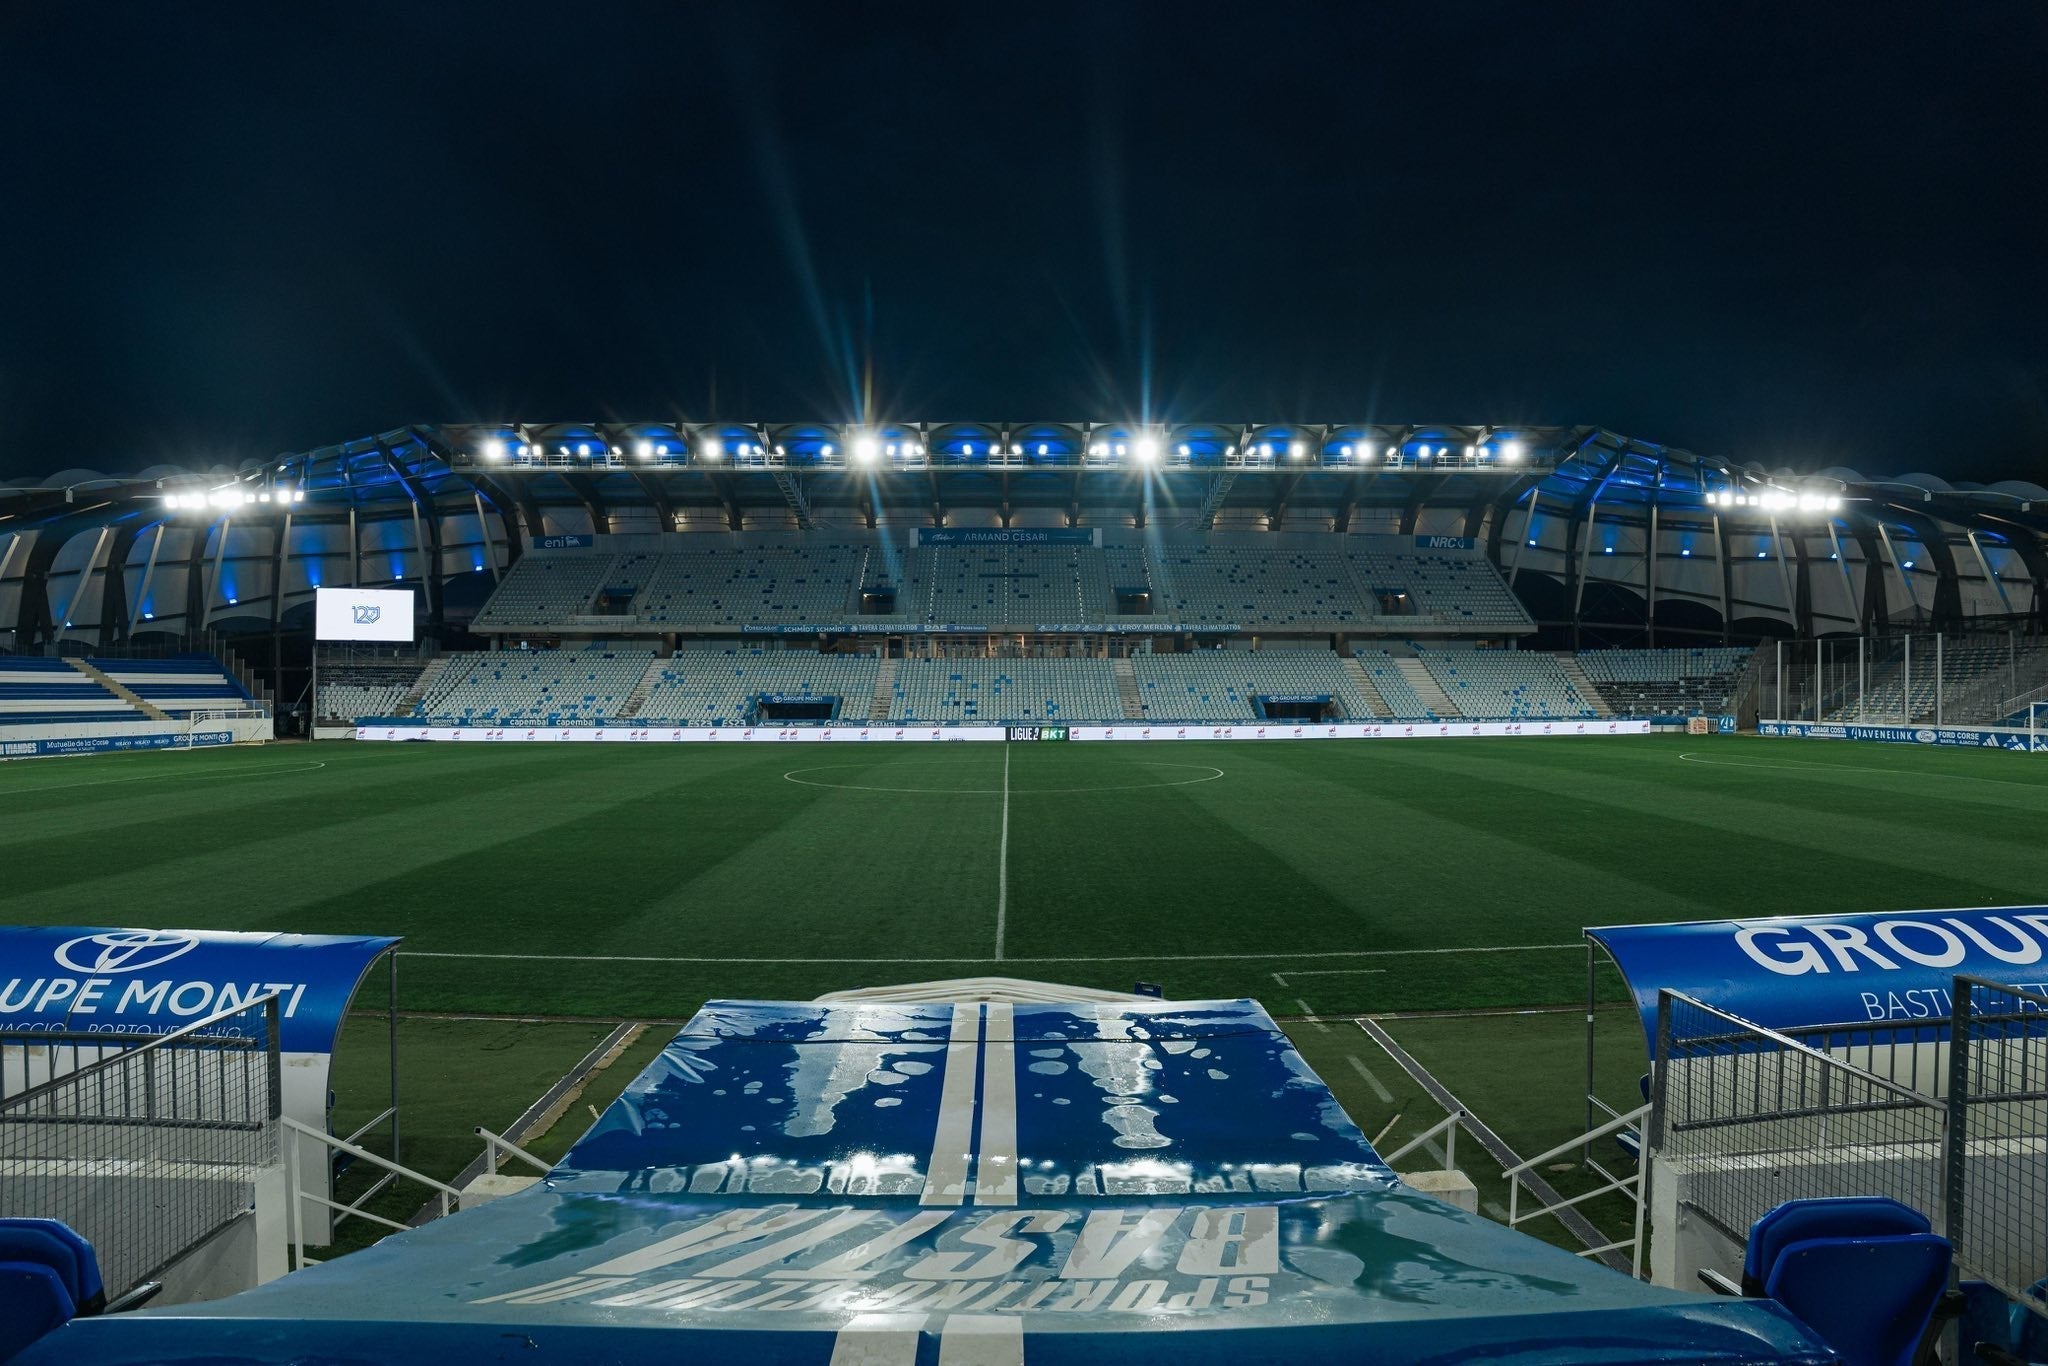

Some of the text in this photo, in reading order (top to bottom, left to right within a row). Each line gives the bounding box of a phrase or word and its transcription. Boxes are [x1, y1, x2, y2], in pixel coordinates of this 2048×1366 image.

[964, 533, 1009, 541] ARMAND
[544, 537, 564, 548] eni
[1430, 536, 1457, 548] NRC
[924, 624, 948, 632] DAF
[1118, 624, 1143, 632] LEROY
[509, 718, 549, 726] capembal
[556, 718, 595, 726] capembal
[1010, 727, 1033, 741] LIGUE
[1033, 727, 1040, 741] 2
[1041, 727, 1066, 741] BKT
[1810, 726, 1829, 734] GARAGE
[1862, 729, 1913, 740] AVENELINK
[173, 734, 199, 743] GROUPE
[199, 733, 218, 741] MONTI
[1938, 731, 1980, 740] FORD CORSE
[5, 742, 37, 755] VIANDES
[46, 741, 76, 749] Mutuelle
[115, 980, 307, 1018] MONTI
[574, 1206, 1280, 1279] BASTIA
